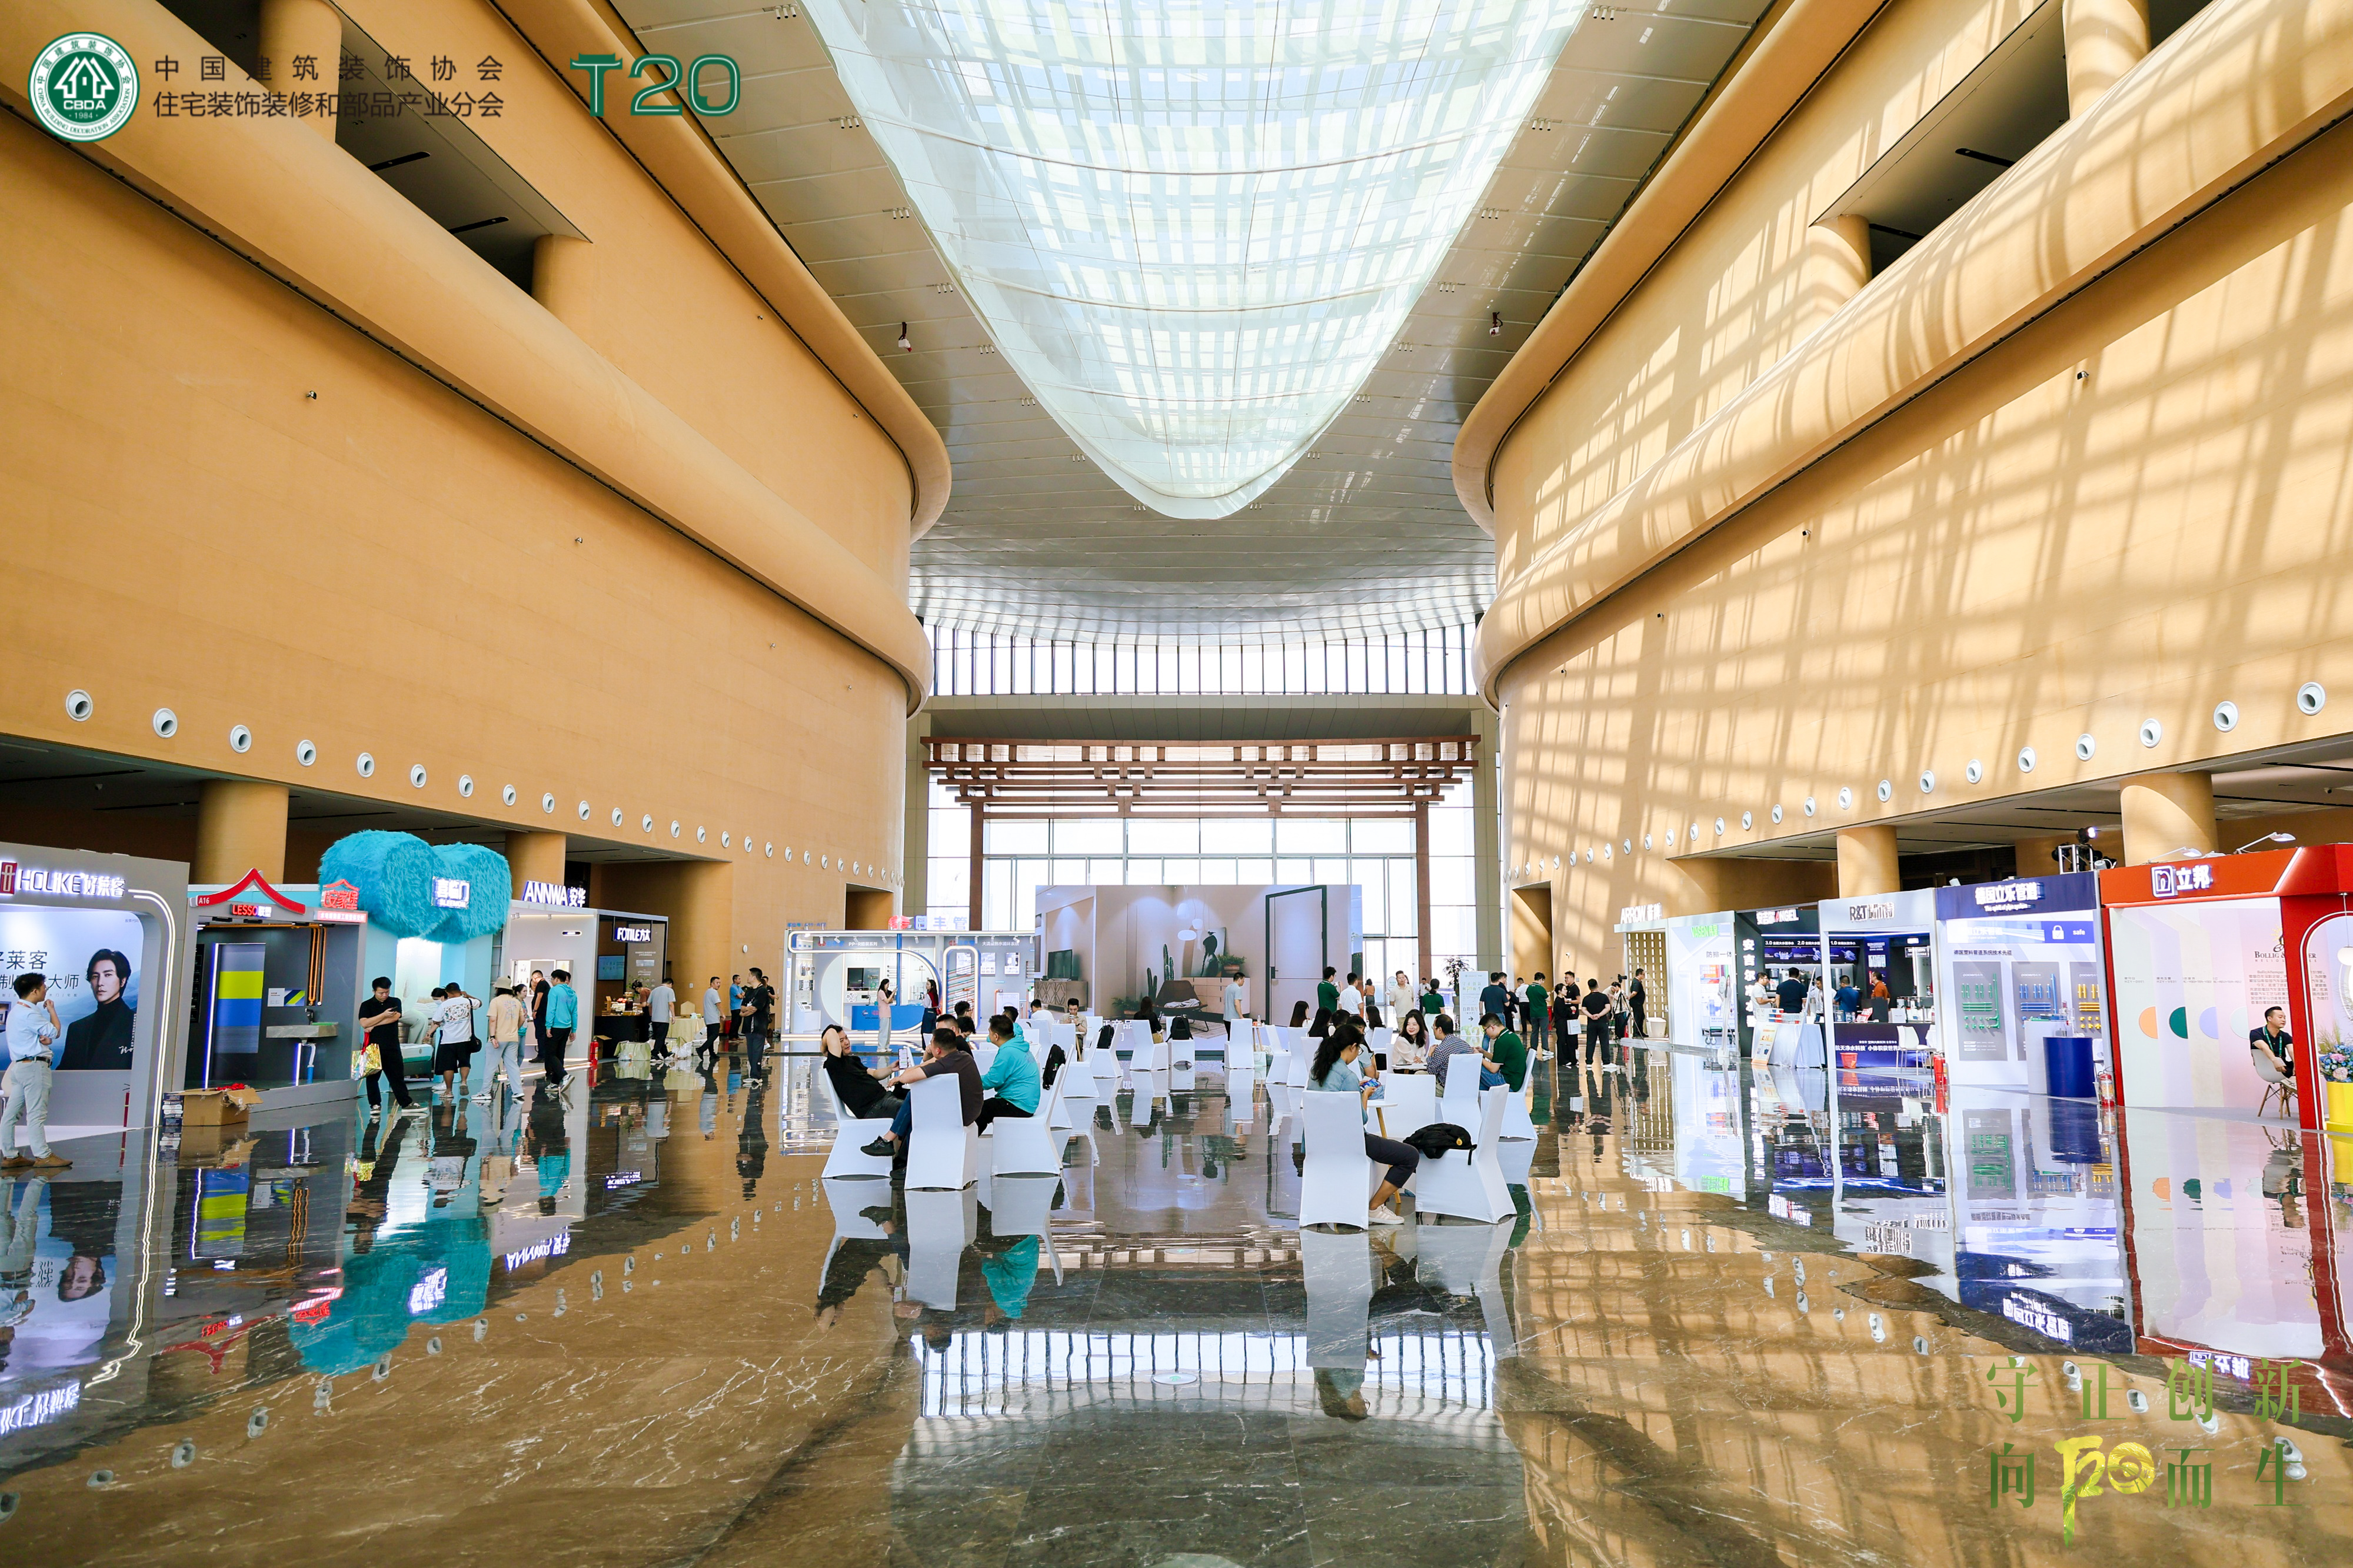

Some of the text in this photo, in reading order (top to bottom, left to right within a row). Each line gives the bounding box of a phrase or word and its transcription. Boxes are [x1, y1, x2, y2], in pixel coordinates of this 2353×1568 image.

[17, 869, 126, 897] HOLIKE 好莱客
[2176, 864, 2211, 891] 立邦
[437, 878, 470, 902] 喜临门
[523, 880, 586, 908] ANNWA 安华
[1975, 882, 2039, 905] 德国立乐管道
[232, 905, 258, 916] LESSO
[1620, 905, 1646, 924] ARROW
[1756, 908, 1799, 925] 安吉尔 ANGEL
[1849, 905, 1868, 922] R&T
[914, 916, 968, 931] 日丰管
[1690, 926, 1709, 938] VASEN
[617, 927, 651, 941] FOTILE 方太
